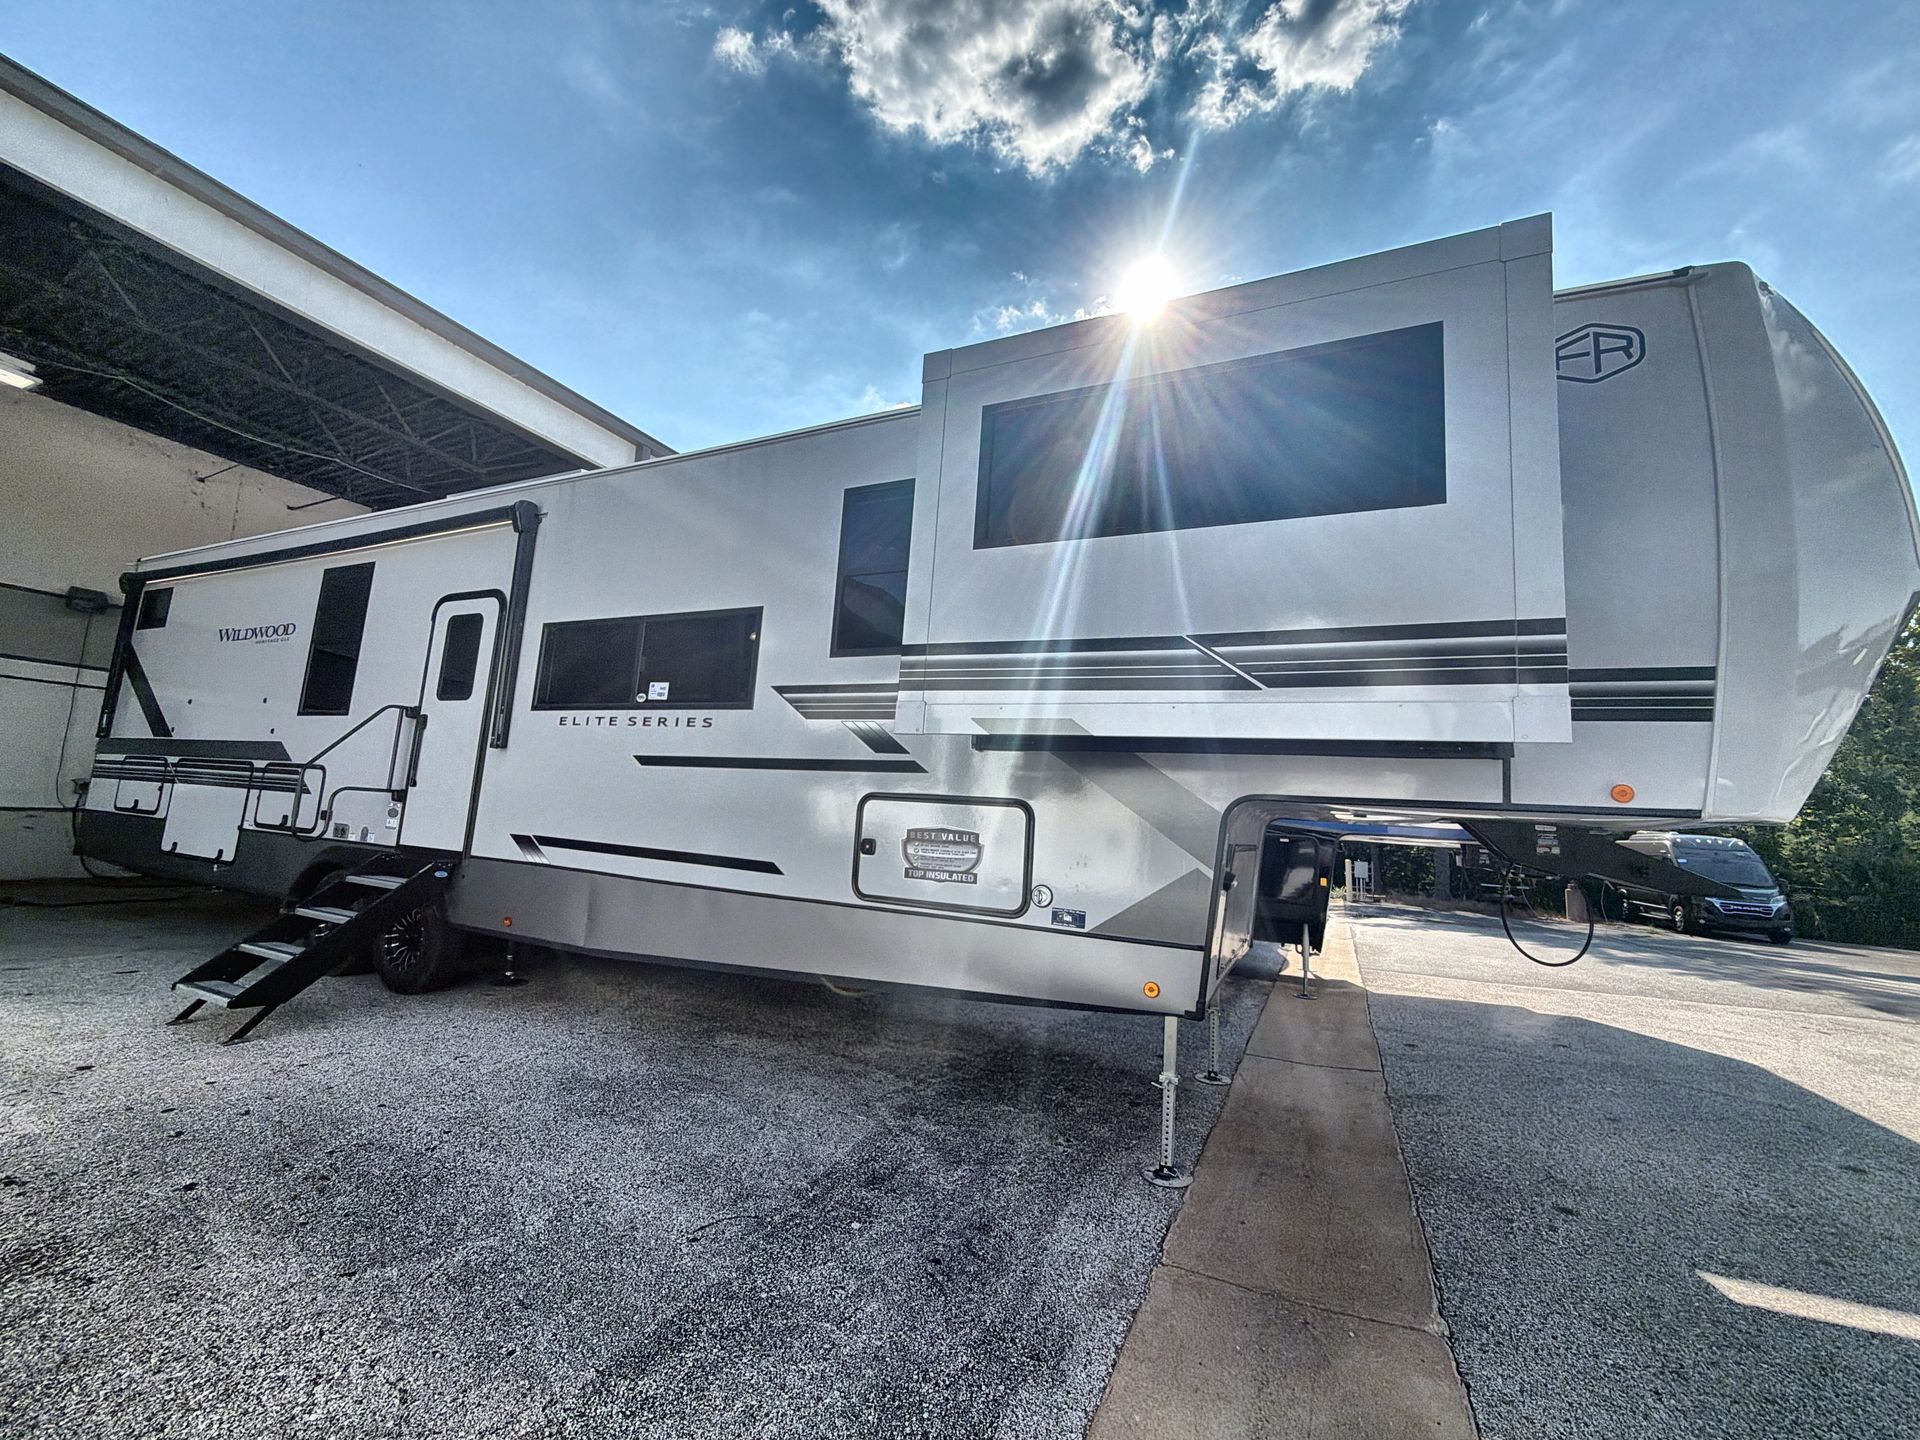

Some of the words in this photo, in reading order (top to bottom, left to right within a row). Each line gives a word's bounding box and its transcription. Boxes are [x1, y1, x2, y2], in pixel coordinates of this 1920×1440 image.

[218, 622, 296, 642] WILDWOOD
[559, 716, 619, 727] ELITE
[627, 716, 713, 728] SERIES
[909, 831, 937, 840] BEST
[941, 832, 976, 842] VALUE
[908, 869, 924, 878] TOP
[926, 870, 975, 882] INSULATED
